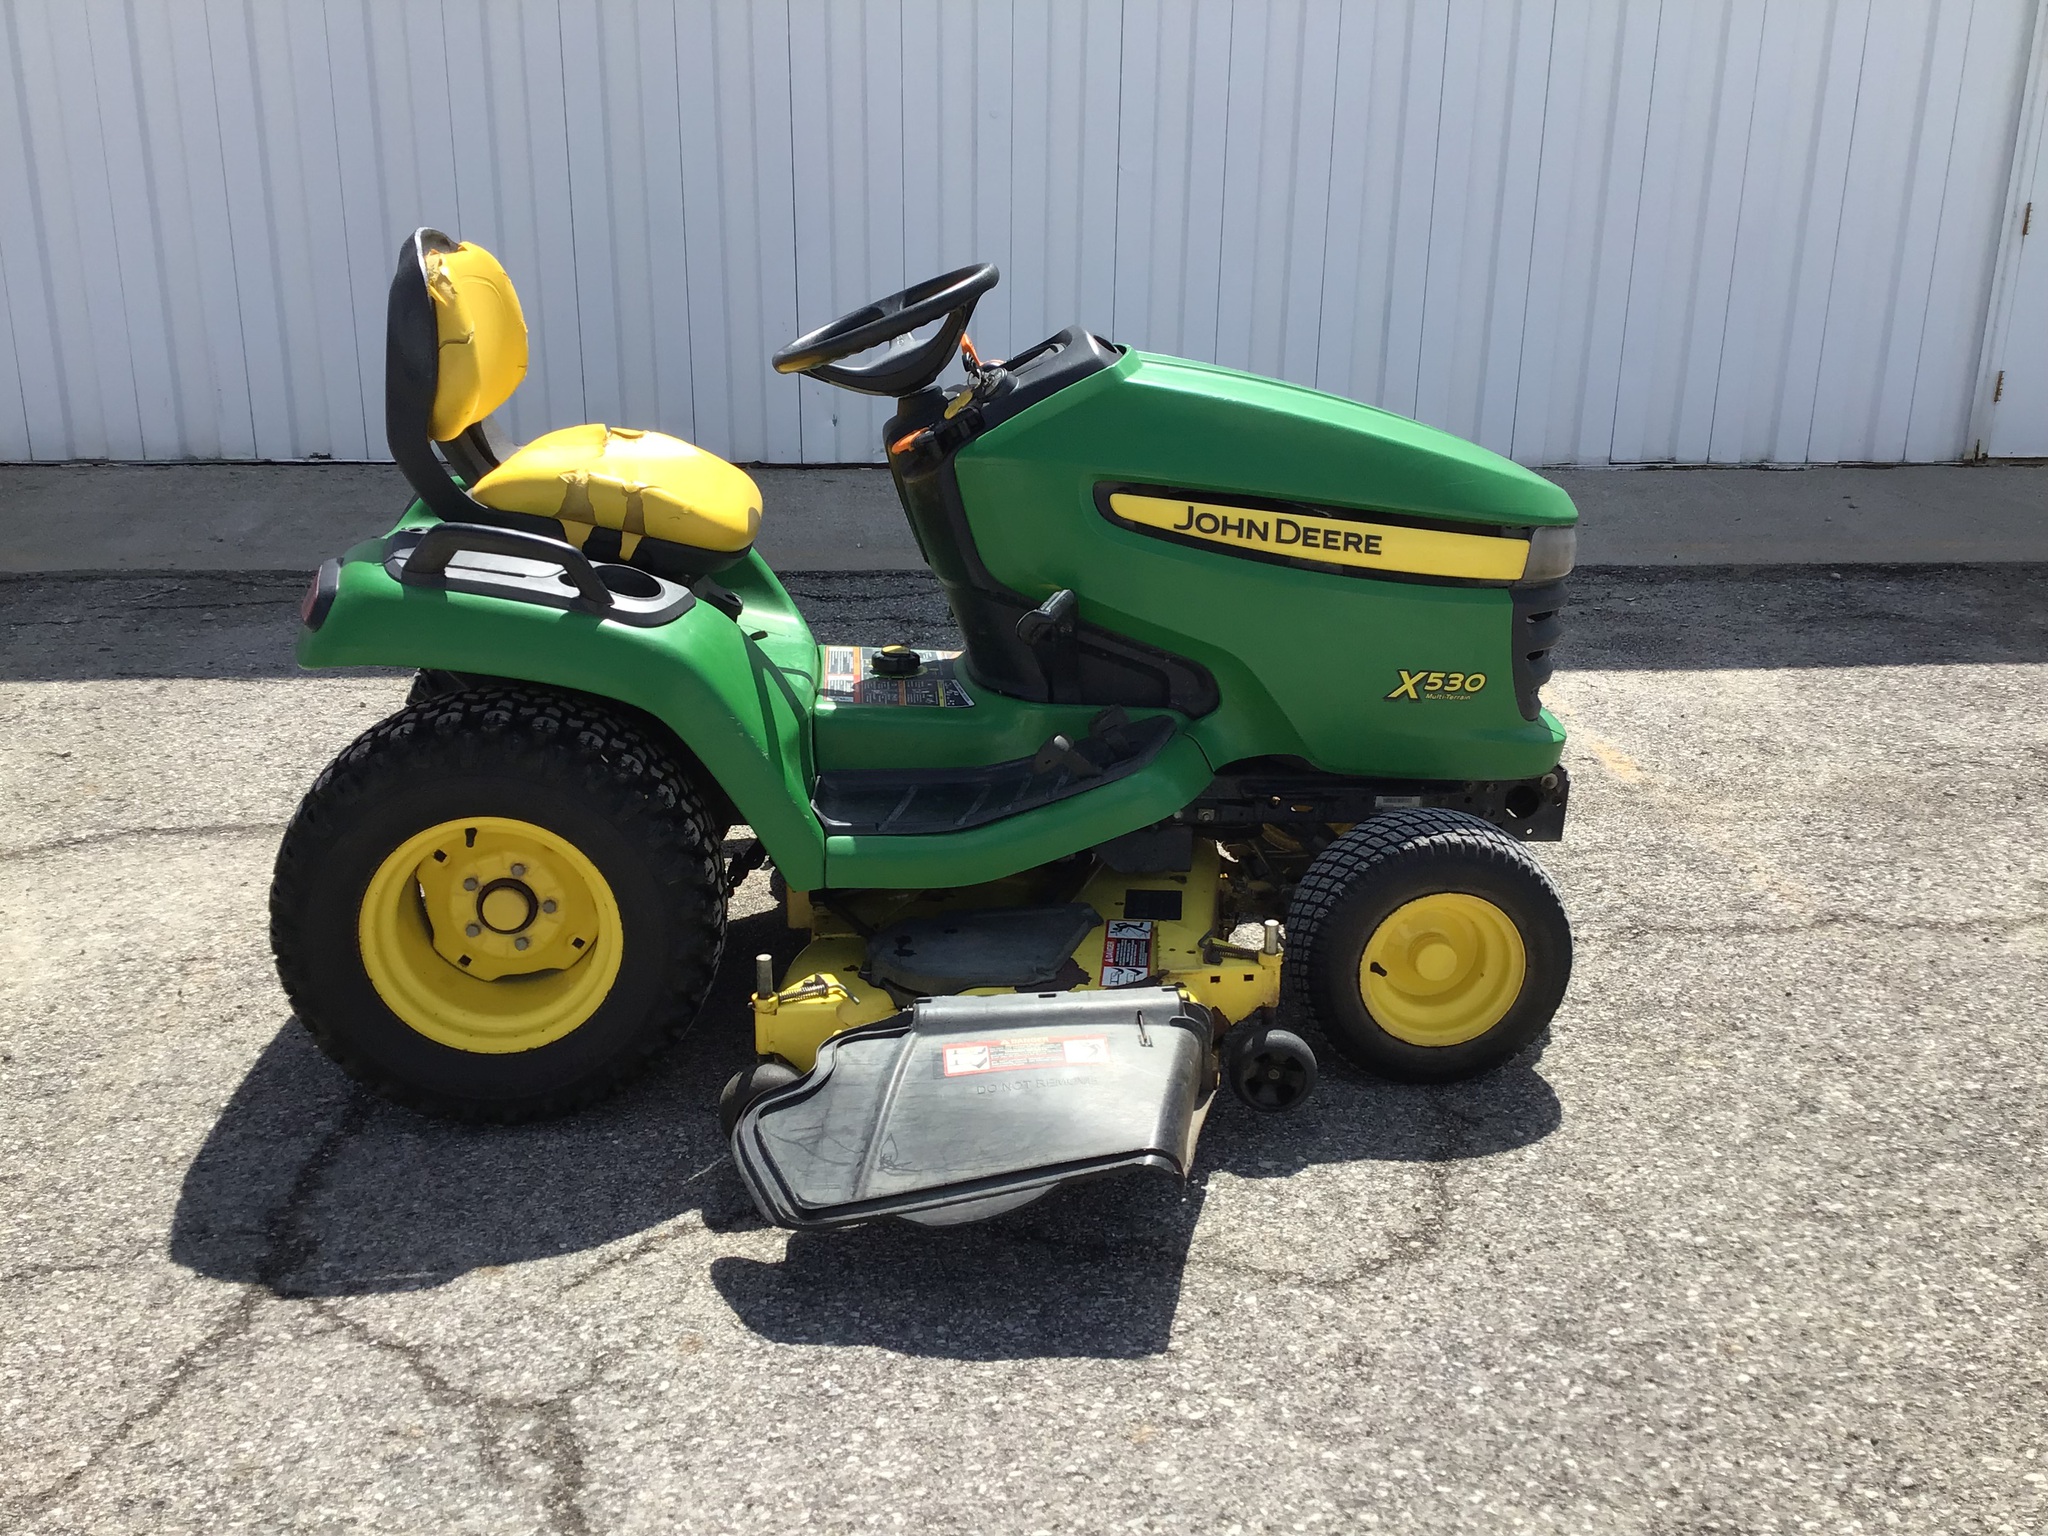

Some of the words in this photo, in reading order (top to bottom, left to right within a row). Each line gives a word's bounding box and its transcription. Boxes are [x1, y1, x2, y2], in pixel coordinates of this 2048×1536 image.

[1173, 505, 1270, 541] JOHN
[1275, 519, 1383, 555] DEERE
[1386, 669, 1487, 701] X530
[1425, 693, 1471, 701] Multi-Terrain
